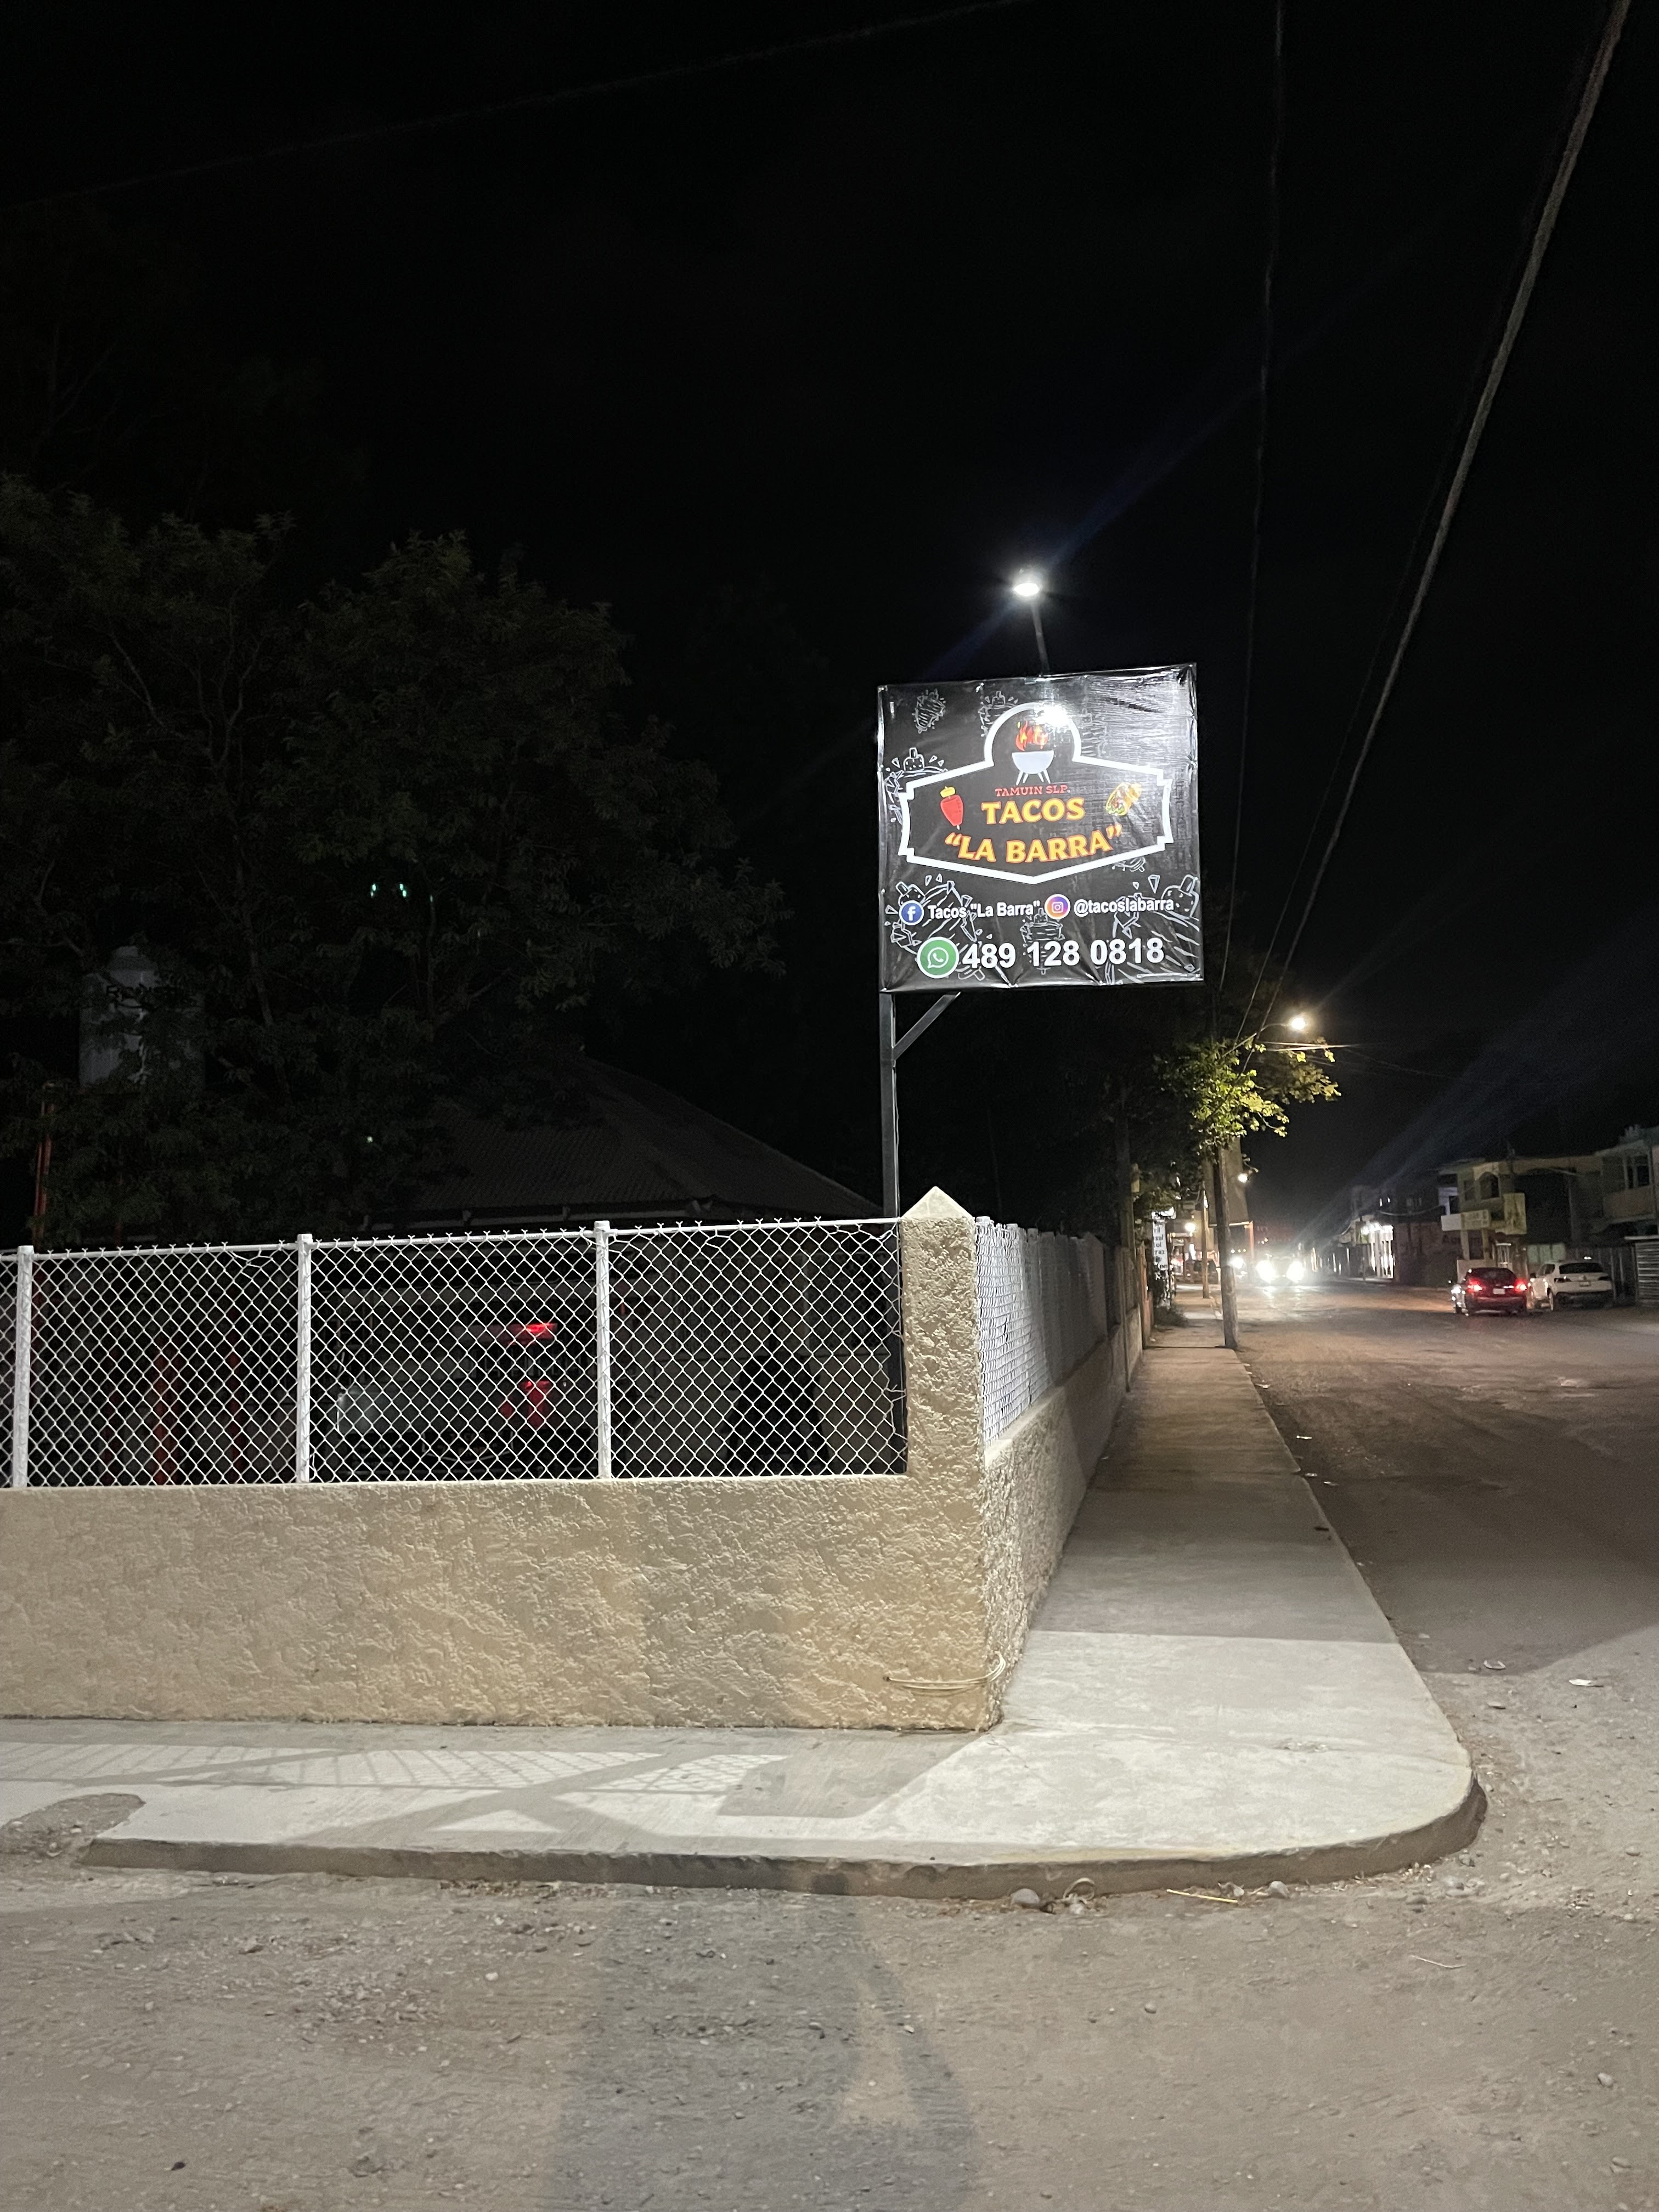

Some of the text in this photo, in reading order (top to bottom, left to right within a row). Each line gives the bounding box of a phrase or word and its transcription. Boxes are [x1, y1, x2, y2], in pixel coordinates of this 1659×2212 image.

[995, 786, 1043, 797] TAMUIN
[981, 797, 1086, 825] TACOS
[928, 900, 1041, 919] Tacos "La Barra"
[1074, 897, 1175, 917] @tacoslabarra
[962, 937, 1165, 969] 489 128 0818
